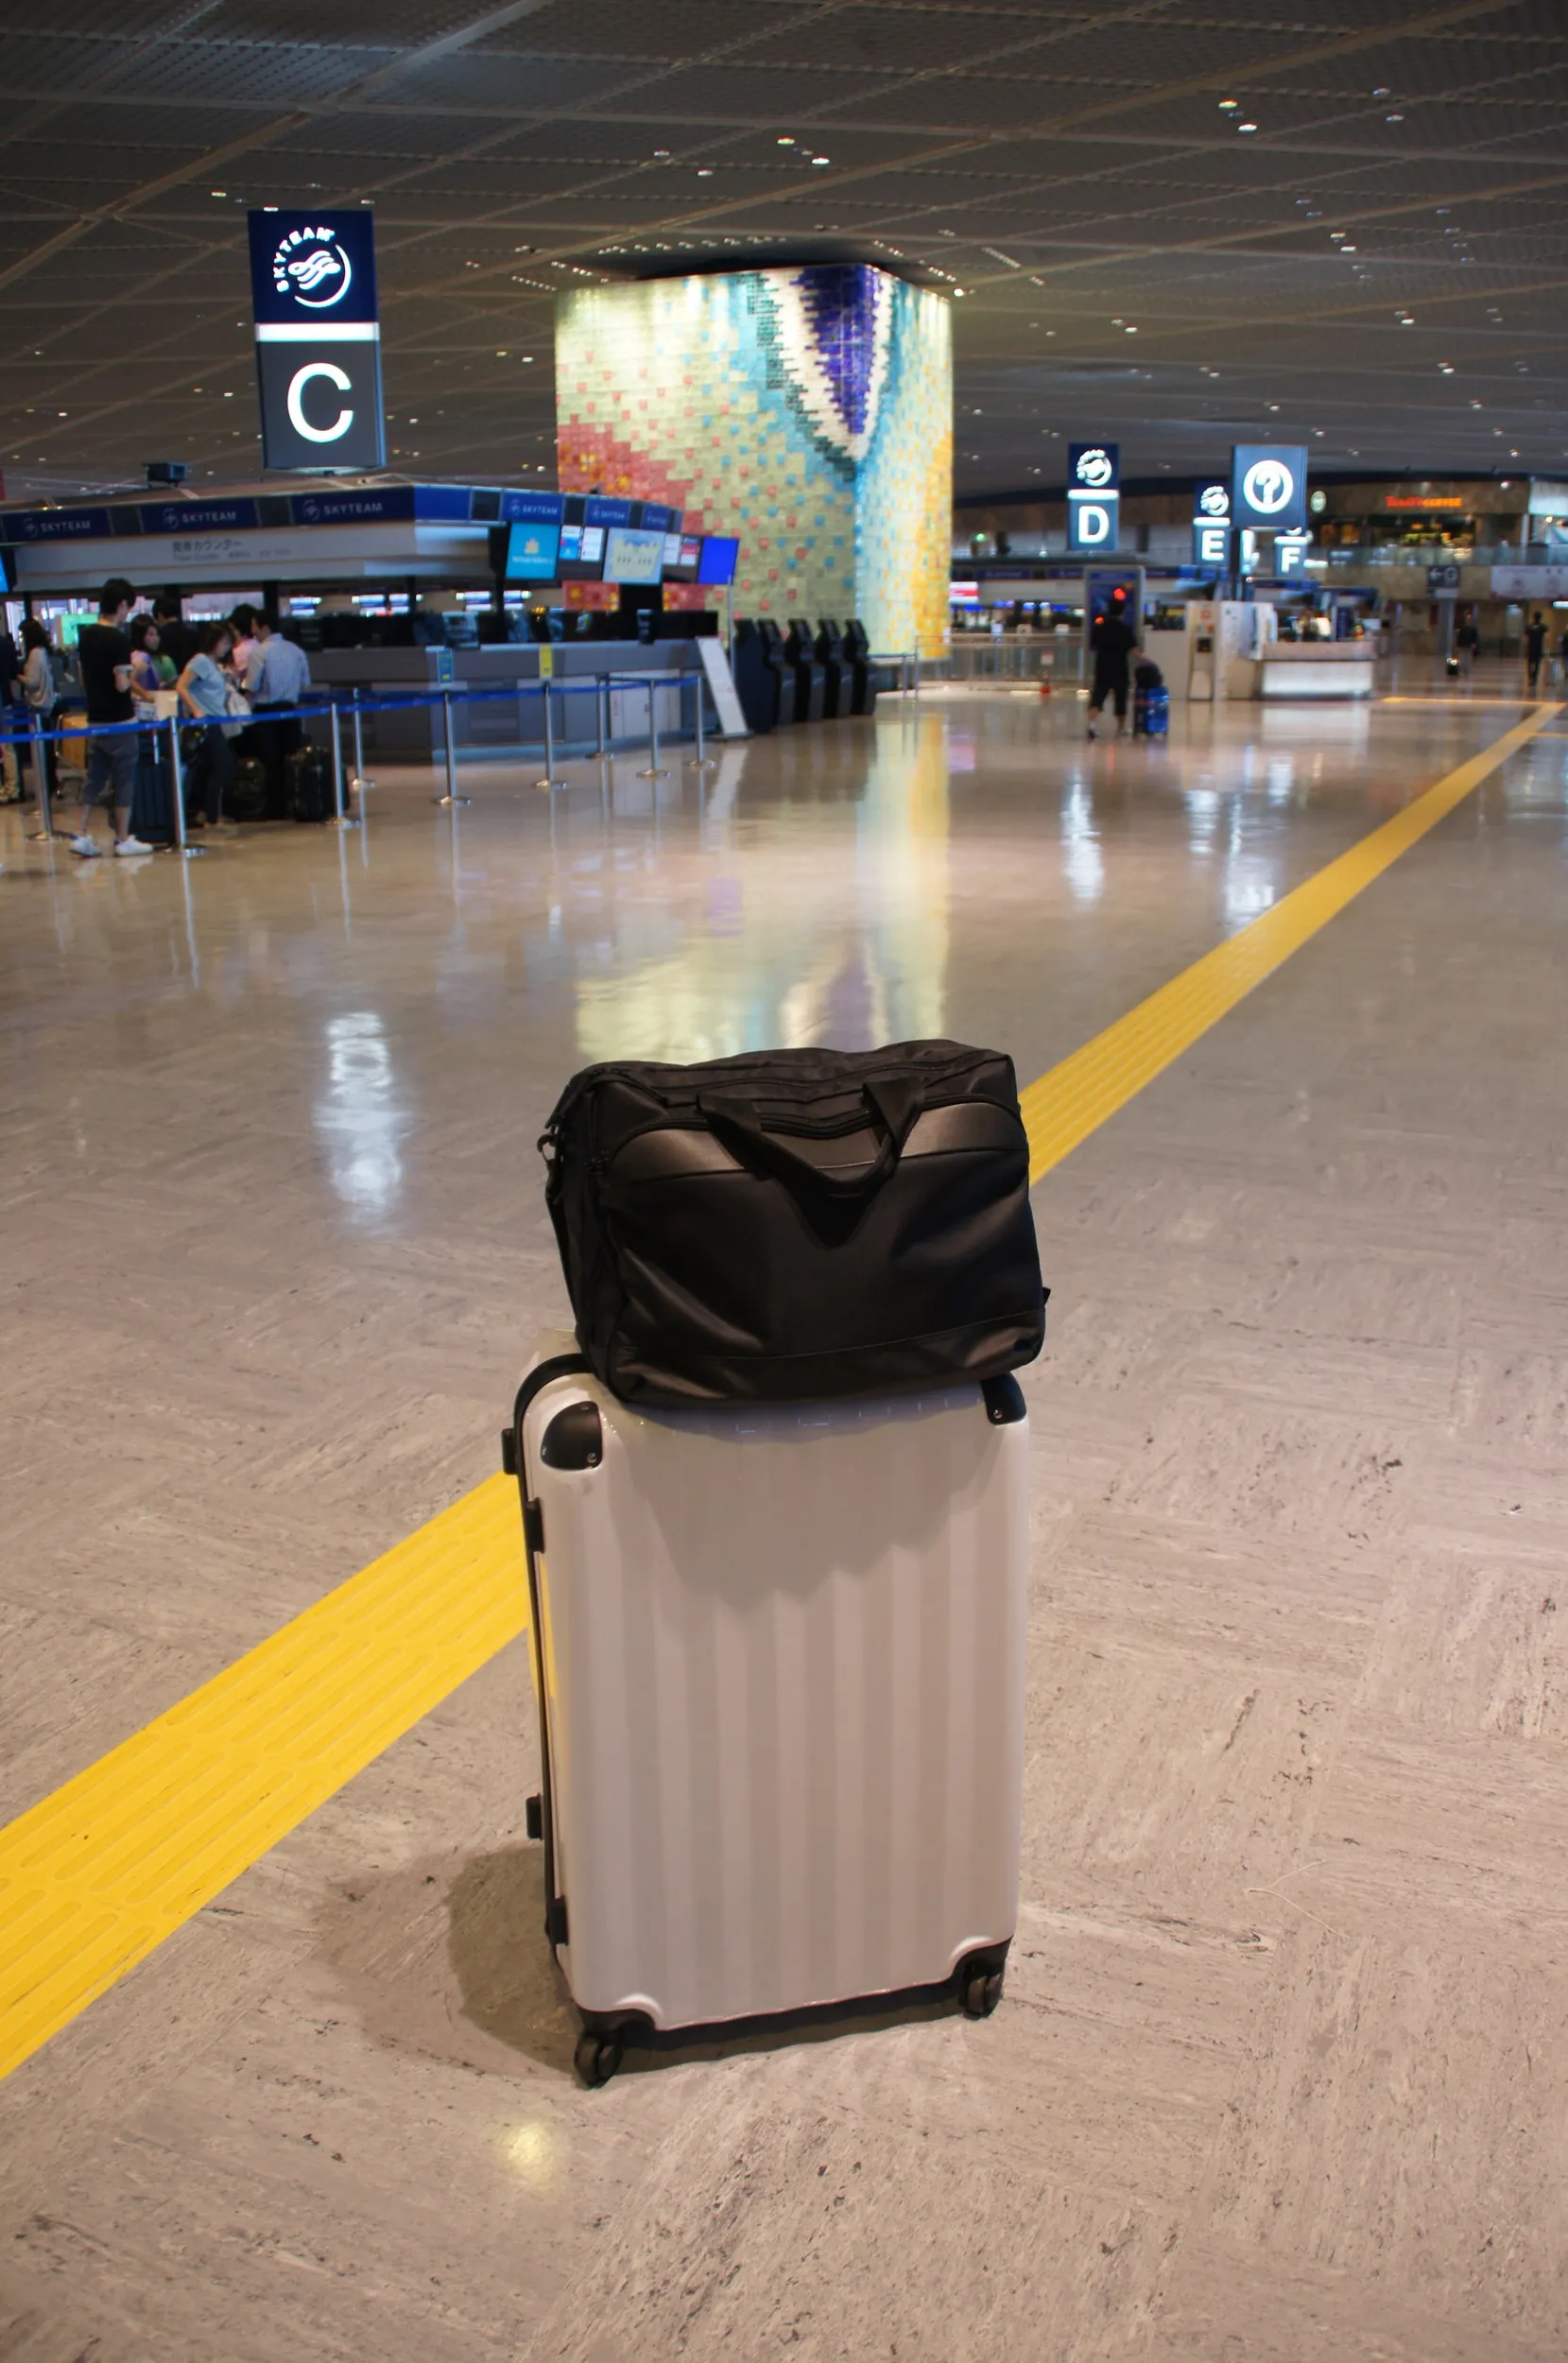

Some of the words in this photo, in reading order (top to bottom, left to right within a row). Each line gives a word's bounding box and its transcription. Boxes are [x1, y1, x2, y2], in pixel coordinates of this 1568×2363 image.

[273, 227, 336, 292] SKYTEAM
[287, 363, 353, 442] C
[181, 511, 236, 524] SKYTEAM
[323, 503, 383, 515] SKYTEAM
[523, 506, 558, 515] SKYTEAM
[41, 521, 91, 532] SKYTEAM
[1078, 506, 1109, 543] D
[1201, 530, 1225, 561] E
[1282, 547, 1301, 573] F
[1443, 567, 1457, 580] G
